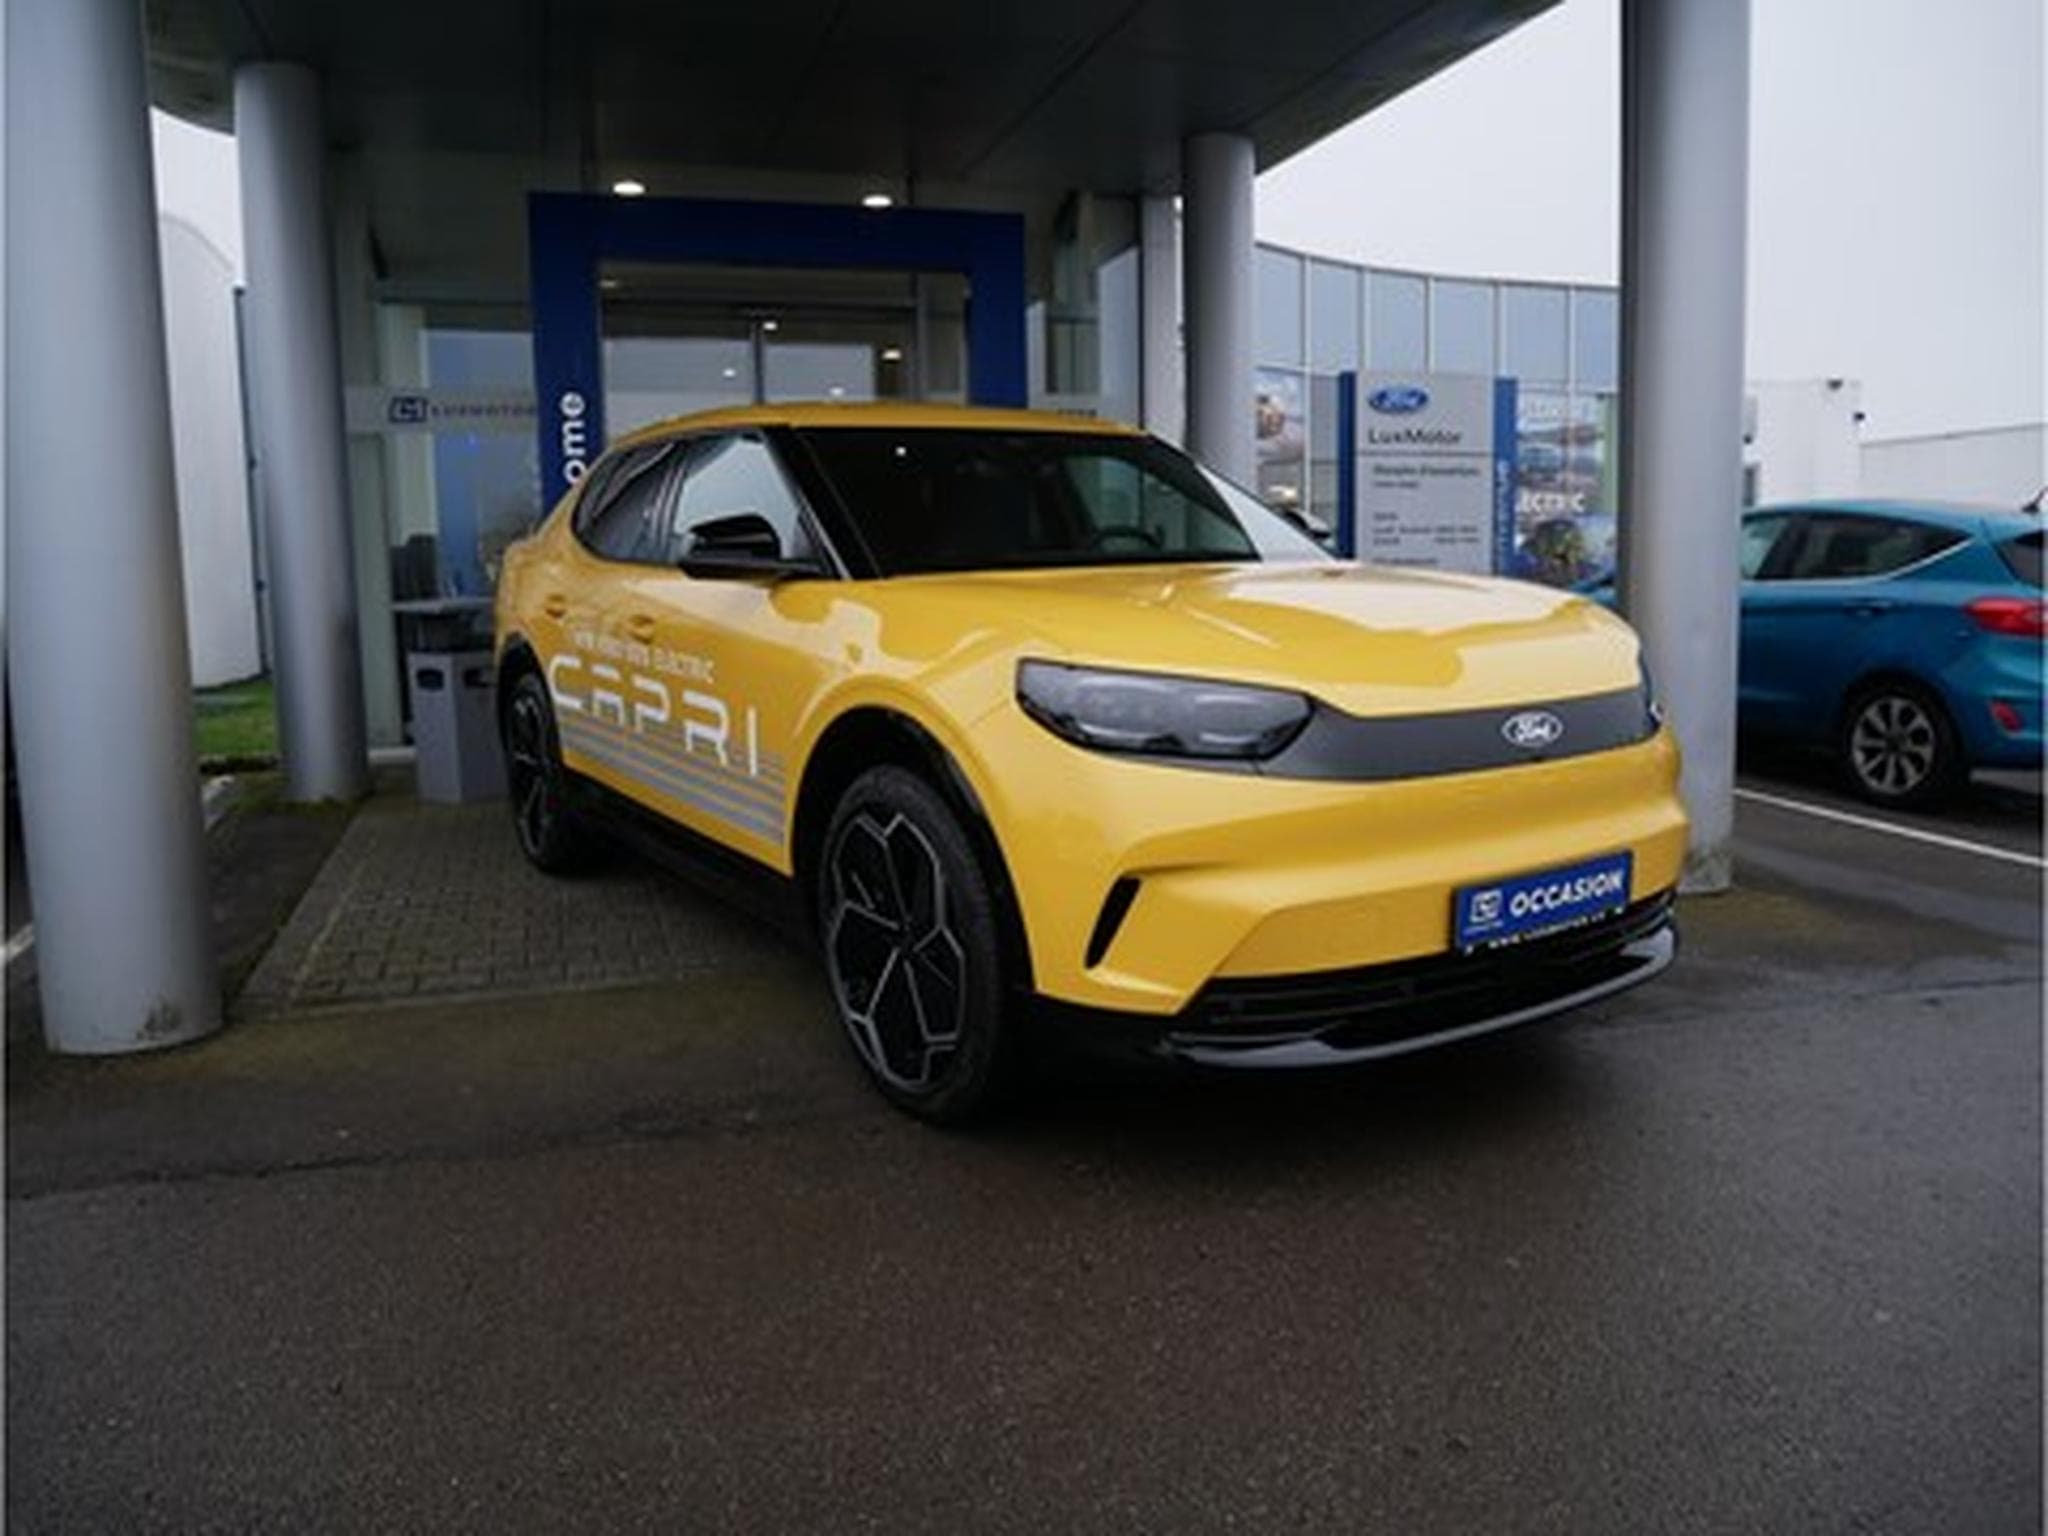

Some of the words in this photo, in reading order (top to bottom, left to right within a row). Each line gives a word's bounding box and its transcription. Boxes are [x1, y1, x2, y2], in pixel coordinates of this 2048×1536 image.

[1378, 389, 1422, 411] Ford
[1368, 428, 1463, 446] LuxMotor
[547, 653, 759, 778] CAPRI
[1510, 716, 1555, 744] Ford
[1508, 869, 1624, 918] OCCASION
